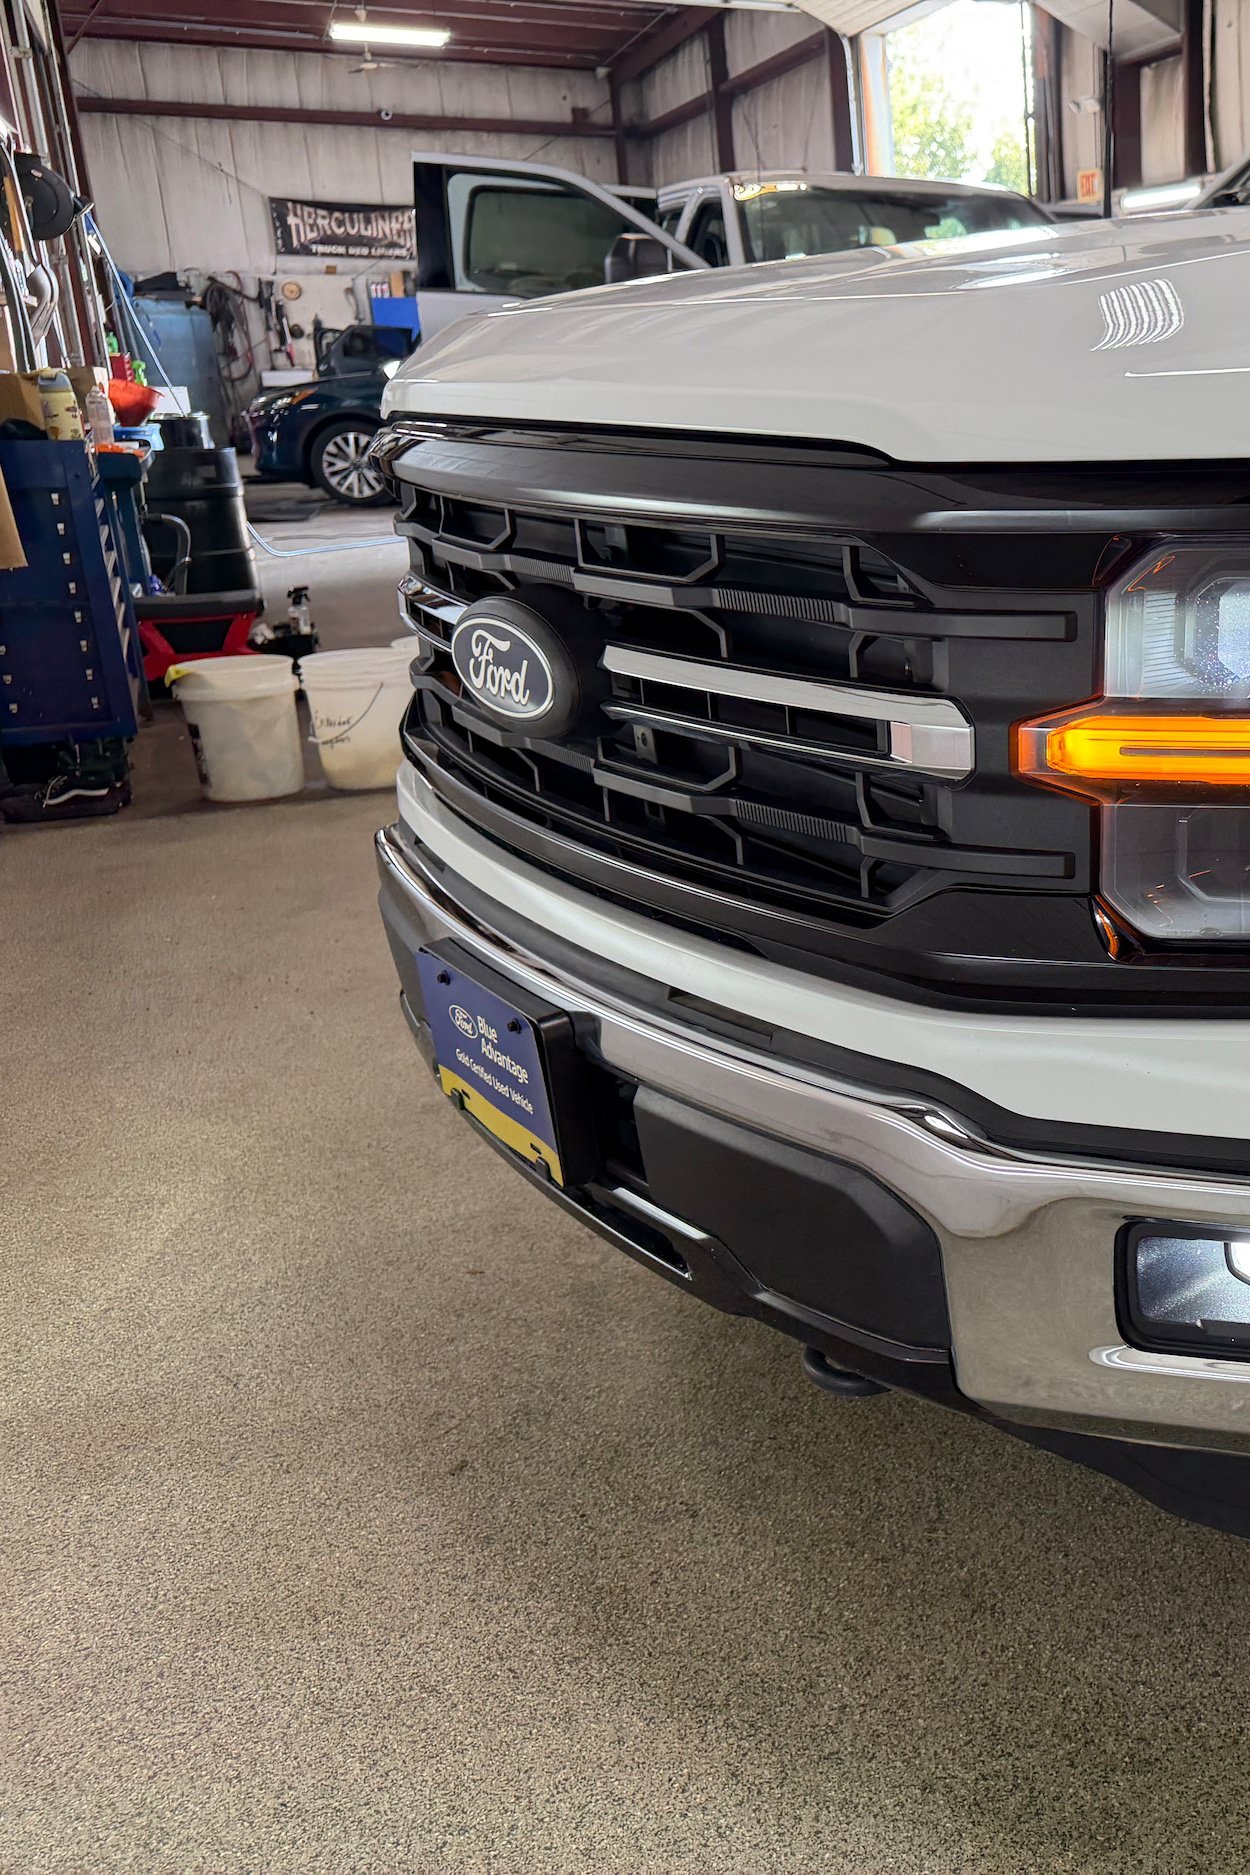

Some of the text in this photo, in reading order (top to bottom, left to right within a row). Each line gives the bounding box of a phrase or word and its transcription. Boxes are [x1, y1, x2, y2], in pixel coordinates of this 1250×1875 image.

[287, 202, 415, 249] HERCULINER
[469, 629, 531, 706] Ford
[454, 1008, 474, 1035] Ford
[477, 1015, 498, 1044] Blue
[455, 1048, 533, 1115] Gold Certified Used Vehicle
[481, 1038, 529, 1084] Advantage
